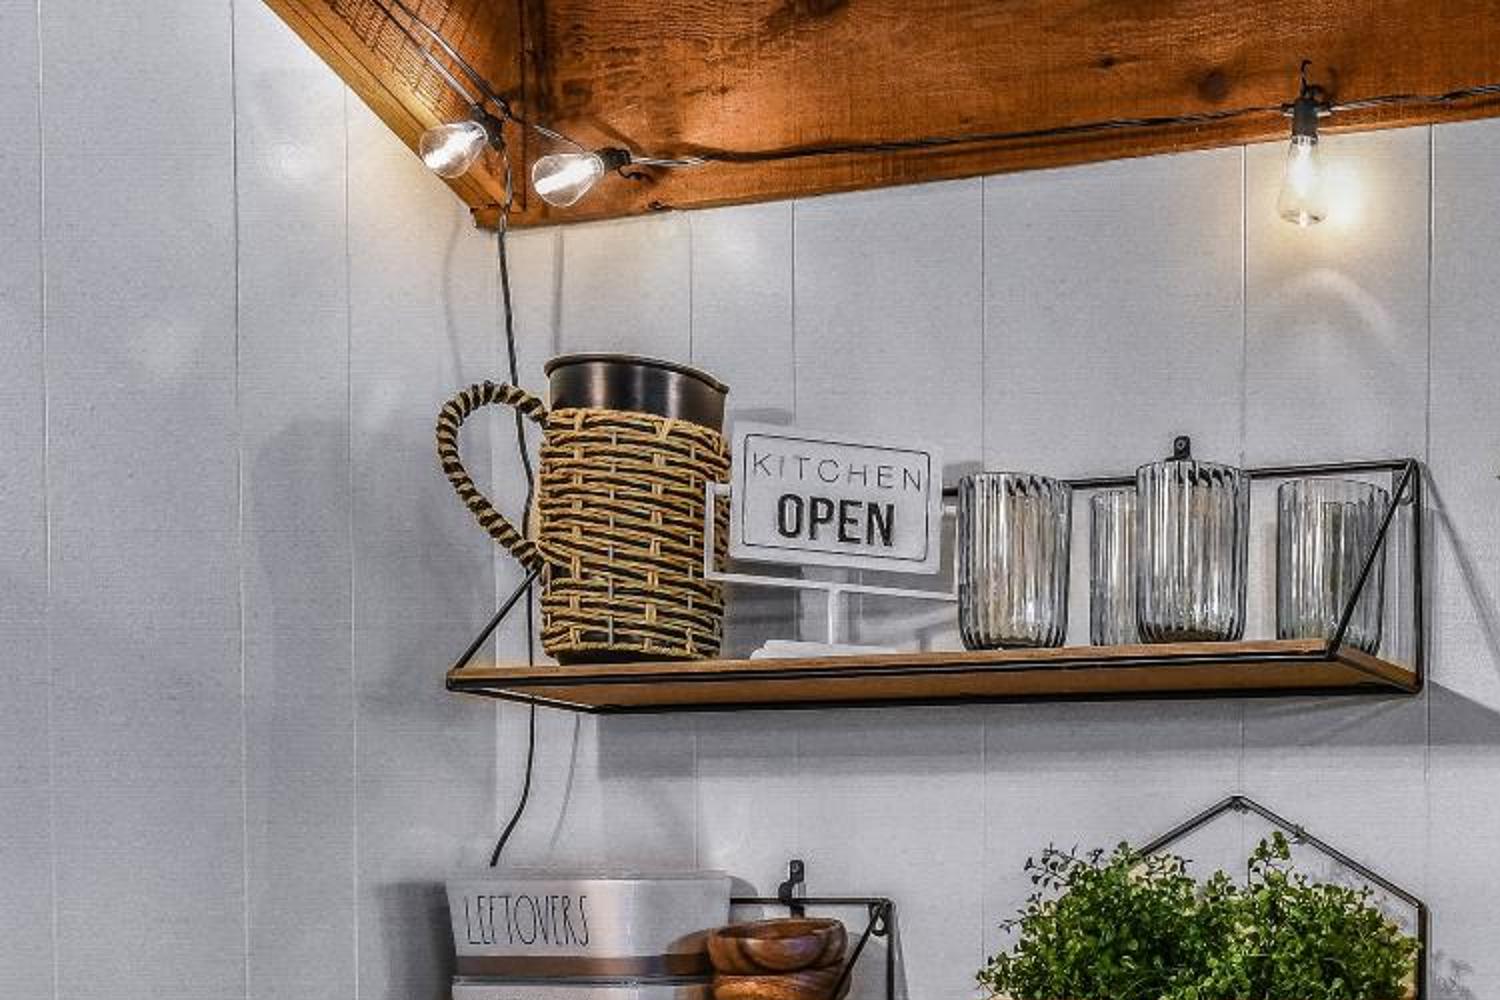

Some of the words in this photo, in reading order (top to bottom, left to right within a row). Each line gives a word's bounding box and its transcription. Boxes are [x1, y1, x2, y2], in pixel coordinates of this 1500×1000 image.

[752, 451, 923, 492] KITCHEN
[777, 493, 895, 547] OPEN
[464, 895, 590, 947] LEFTOVERS
